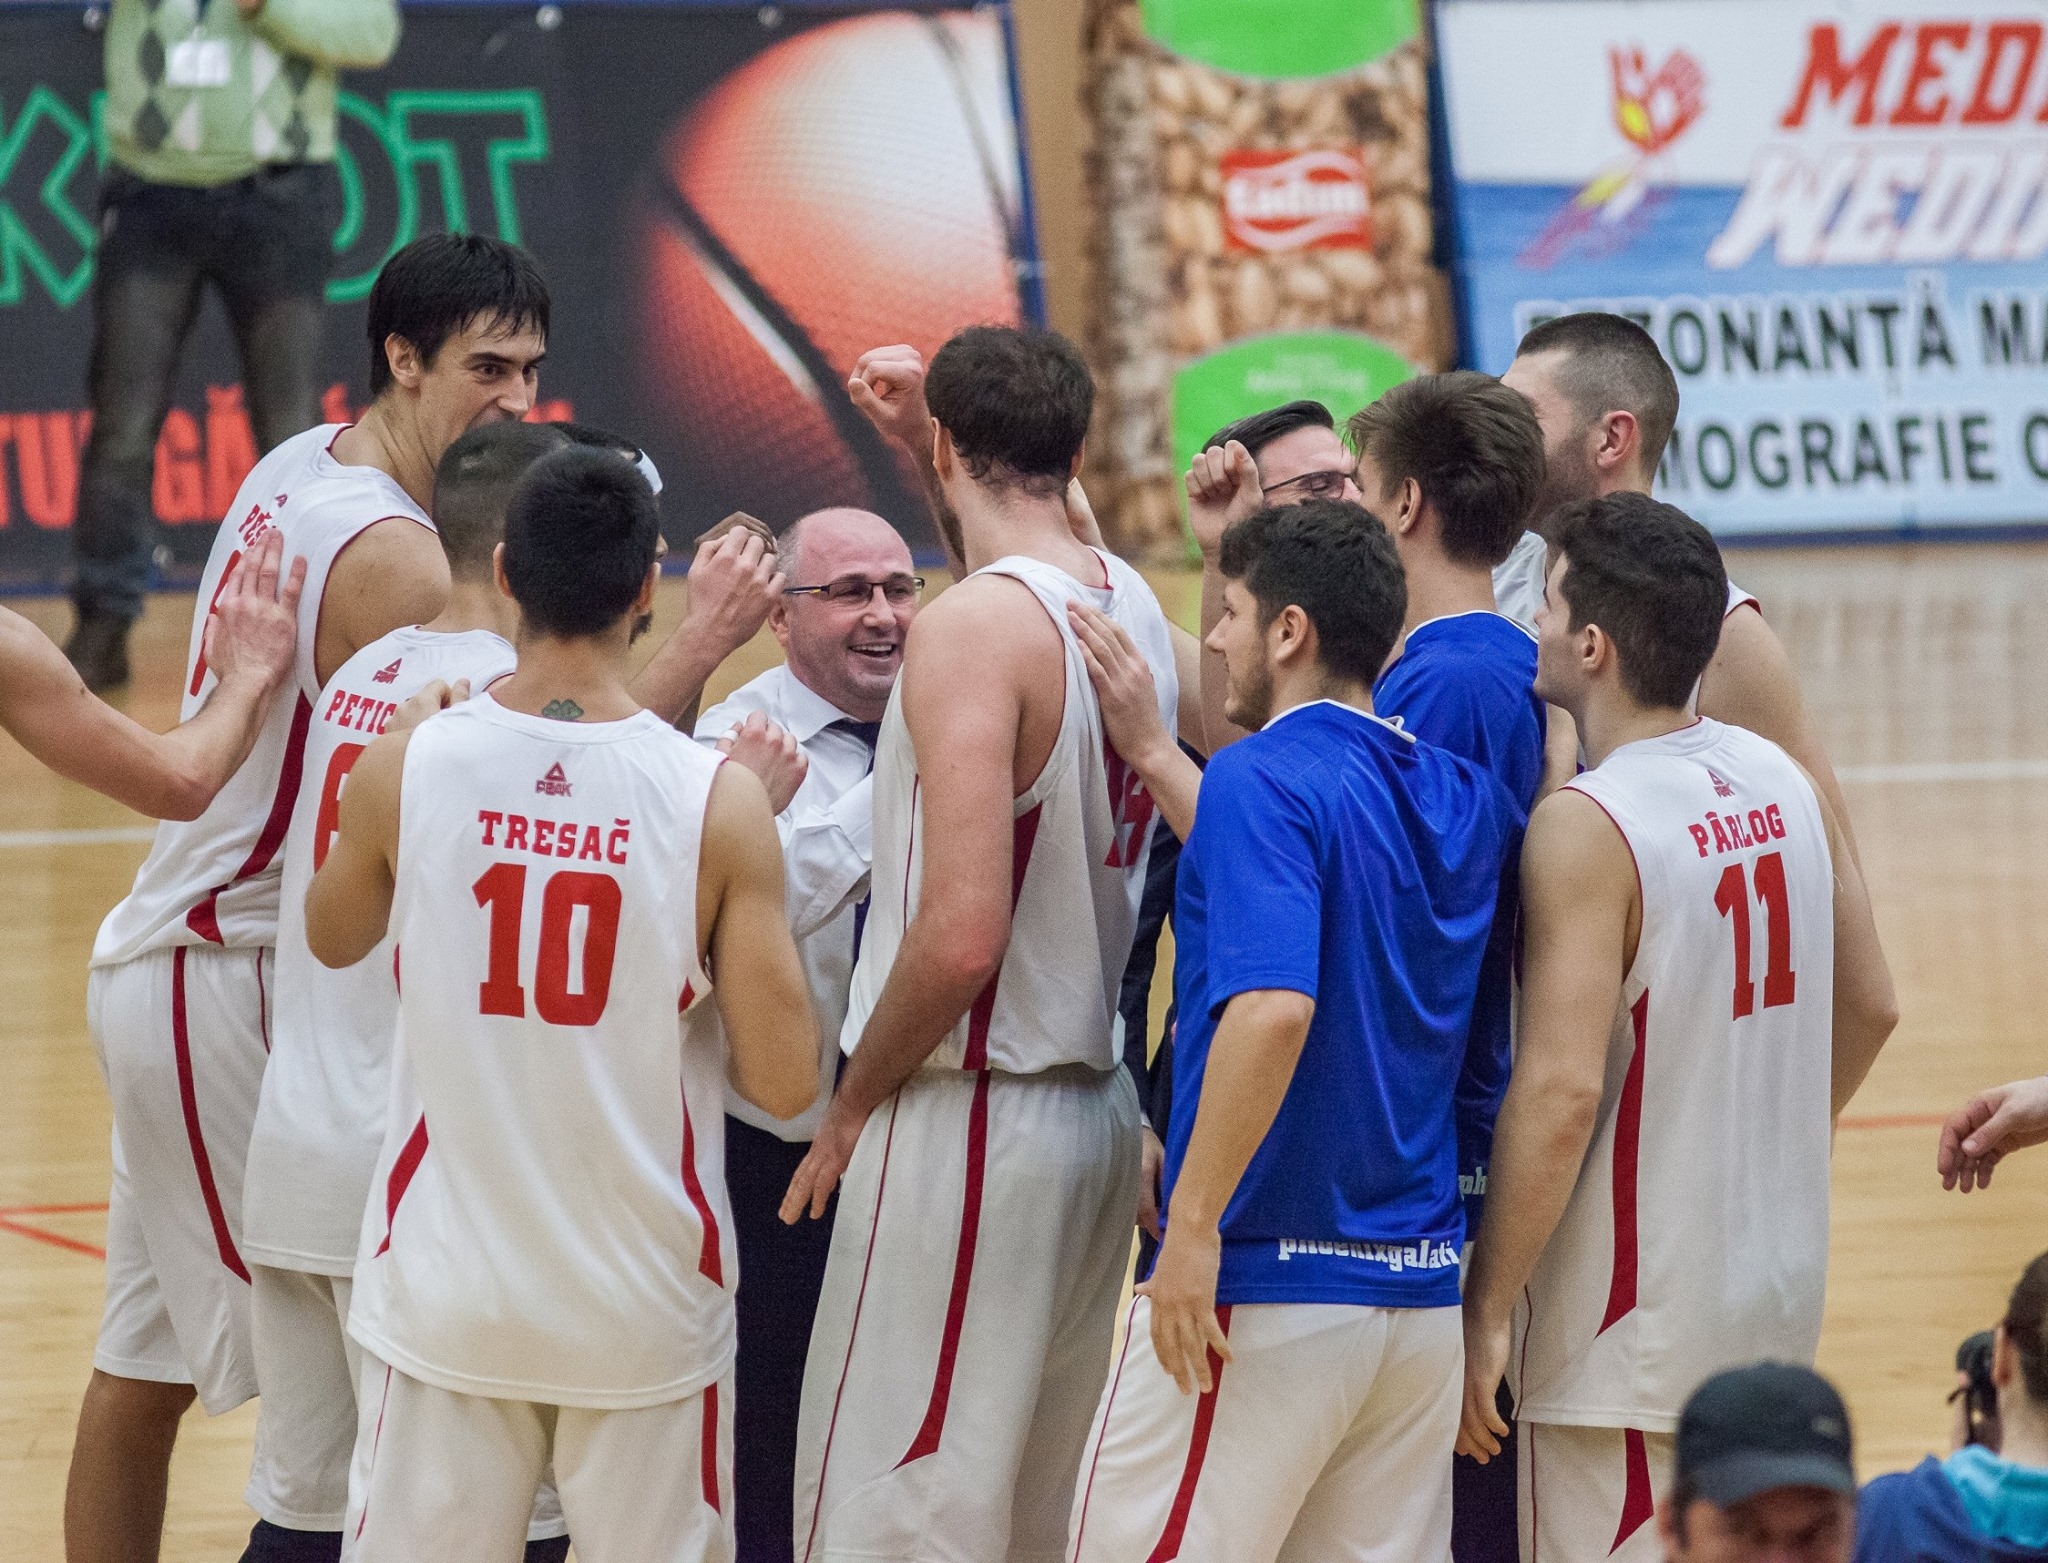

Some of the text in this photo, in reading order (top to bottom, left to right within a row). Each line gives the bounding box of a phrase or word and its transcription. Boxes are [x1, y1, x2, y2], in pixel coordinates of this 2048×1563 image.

[1778, 22, 2048, 128] MED
[535, 779, 573, 797] PEAK
[478, 809, 630, 865] TRESAČ
[1688, 803, 1786, 858] PÂRLOG
[472, 862, 622, 1026] 10
[1714, 851, 1795, 1021] 11
